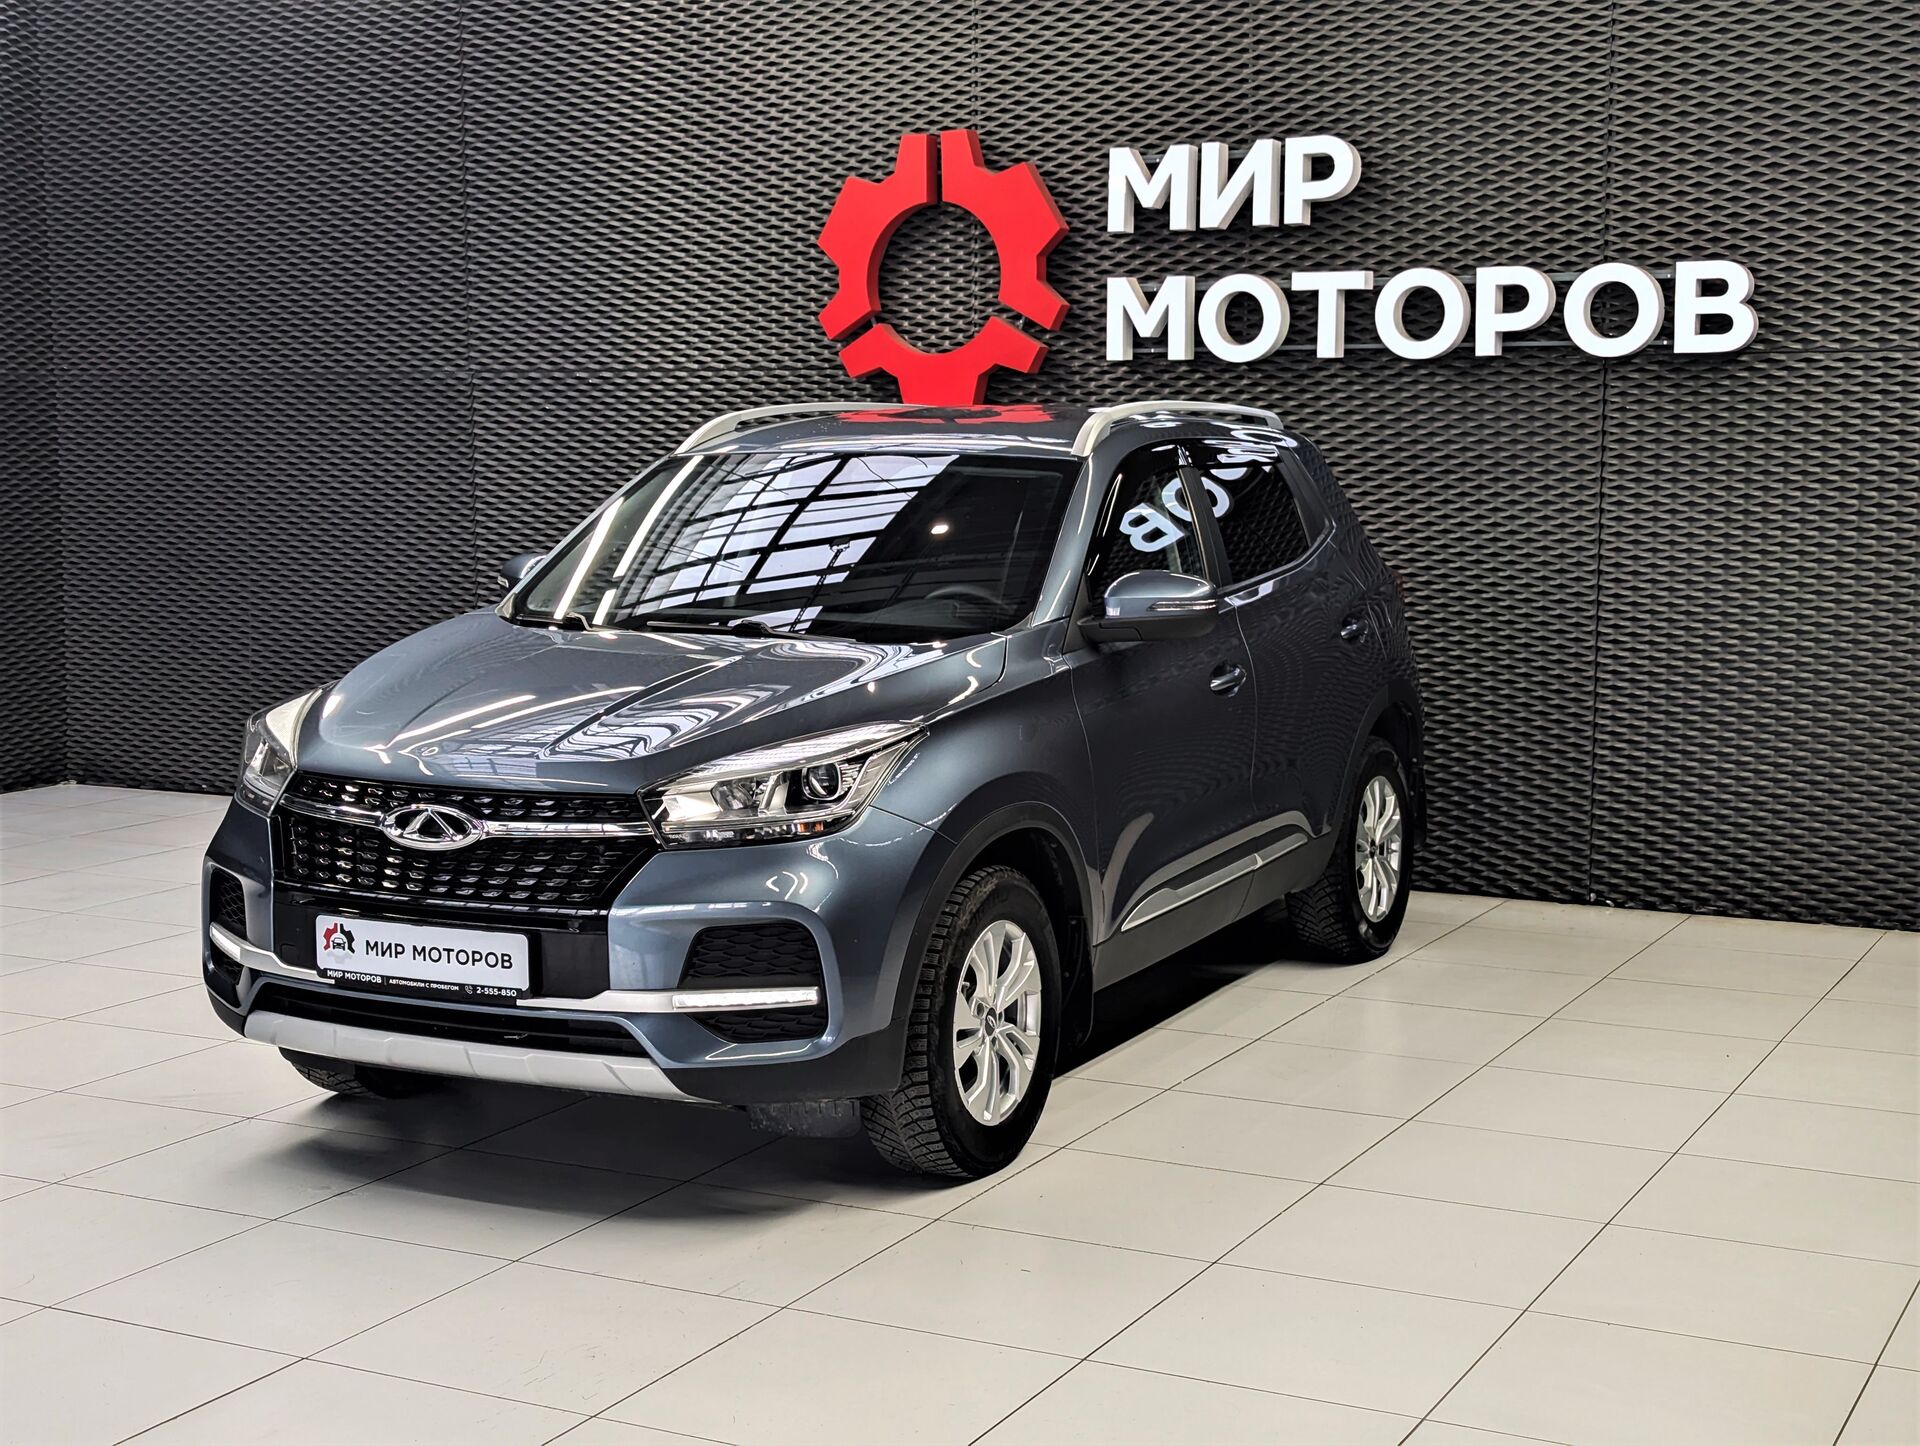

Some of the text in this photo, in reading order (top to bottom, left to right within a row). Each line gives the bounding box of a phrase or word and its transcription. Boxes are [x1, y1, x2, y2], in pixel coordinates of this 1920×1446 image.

[1106, 135, 1362, 233] МИР
[1106, 259, 1759, 361] МОТОРОВ
[365, 939, 513, 969] МИР МОТОРОВ
[327, 969, 382, 983] МИР МОТОРОВ
[389, 978, 424, 988] АВТОМОБИЛИ
[430, 983, 459, 991] ПРОБЕГОМ
[476, 986, 517, 997] 2-555-850
